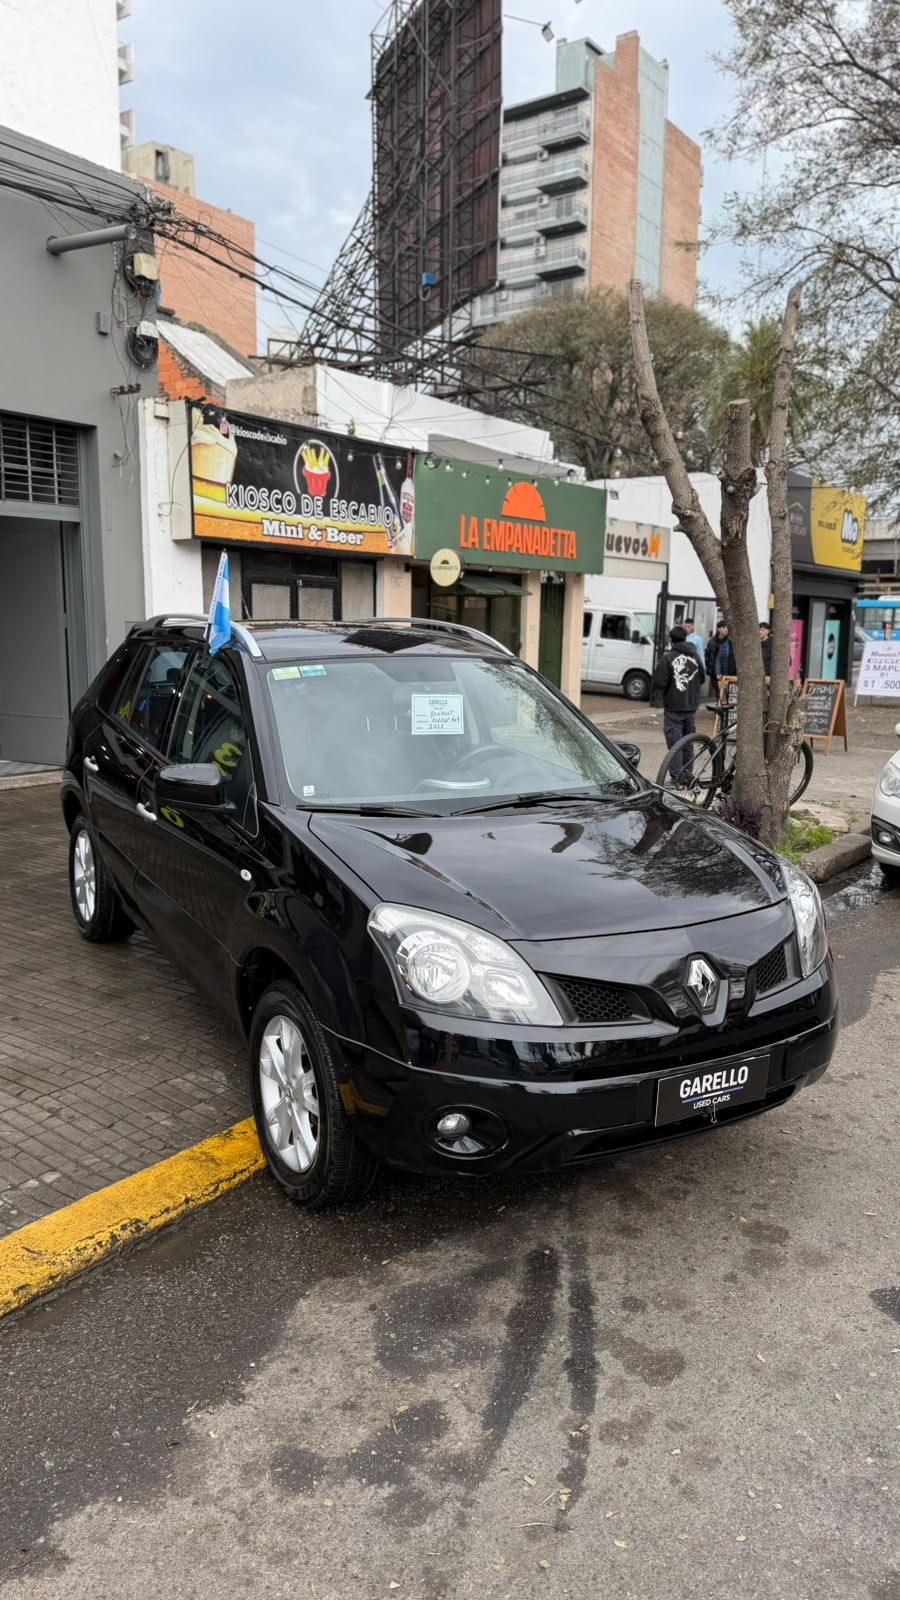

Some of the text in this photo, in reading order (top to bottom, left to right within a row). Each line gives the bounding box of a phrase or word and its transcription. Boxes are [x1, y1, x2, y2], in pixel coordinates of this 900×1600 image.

[226, 483, 297, 516] KIOSCO
[301, 494, 324, 518] DE
[330, 499, 394, 527] ESCABIO
[261, 519, 364, 546] Mini & Beer
[459, 514, 577, 559] LA EMPANADETTA
[606, 533, 648, 556] uevos
[680, 1066, 749, 1098] GARELLO
[693, 1094, 731, 1109] USED CARS
